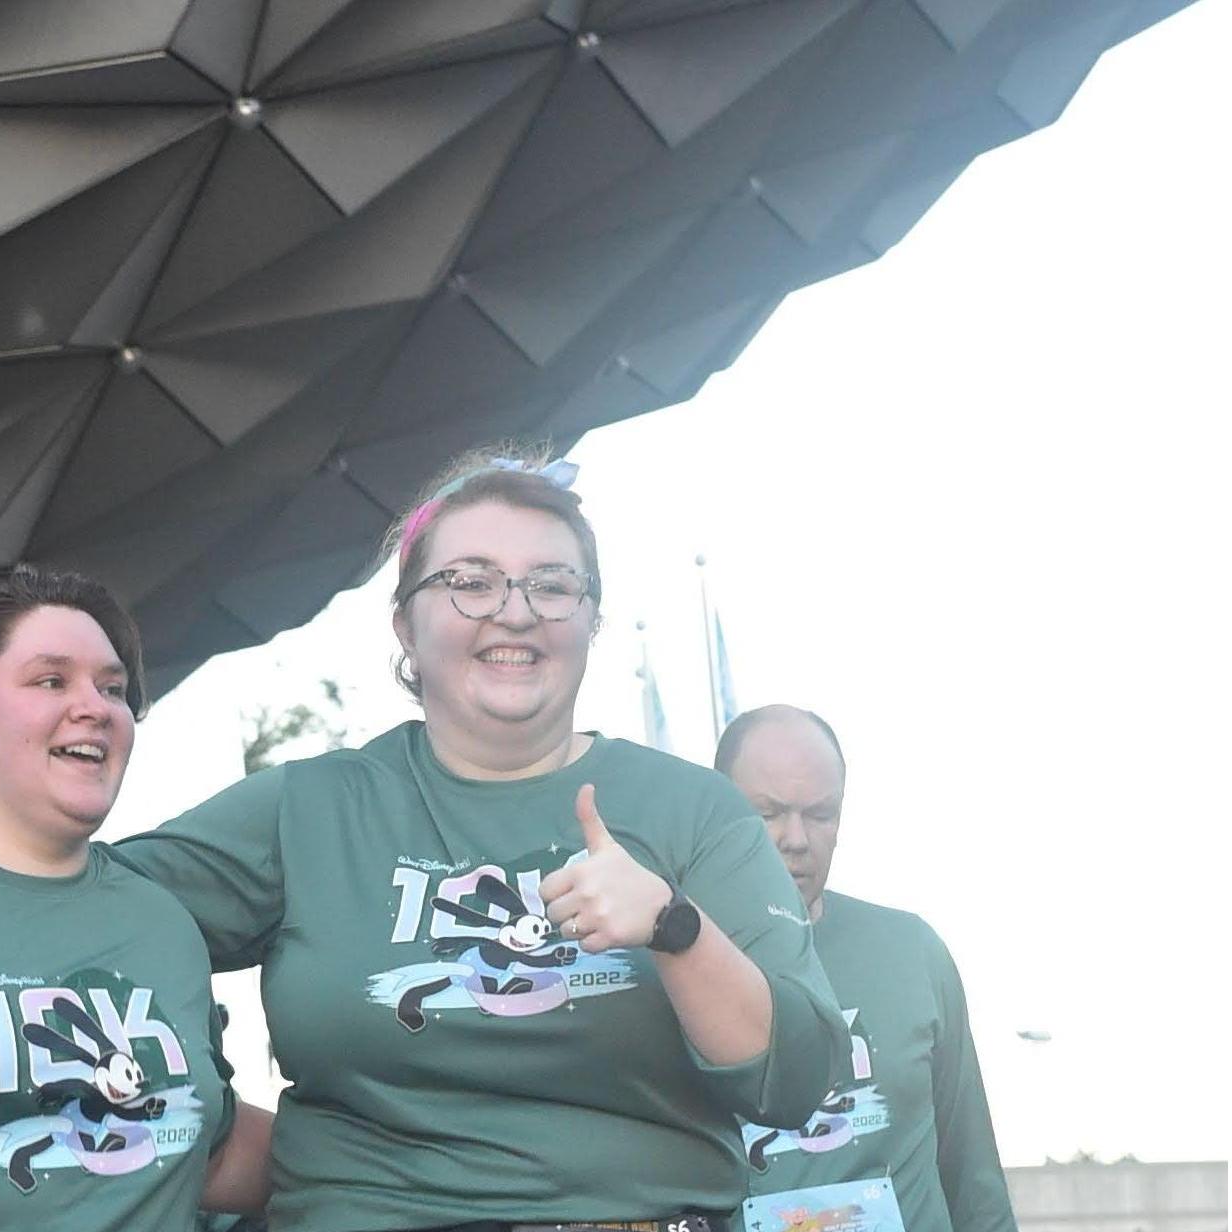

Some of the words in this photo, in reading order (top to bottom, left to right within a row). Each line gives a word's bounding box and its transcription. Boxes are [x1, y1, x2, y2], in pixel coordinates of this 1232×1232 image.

[569, 971, 621, 987] 2022
[852, 1114, 883, 1128] 2022
[156, 1128, 198, 1143] 2022
